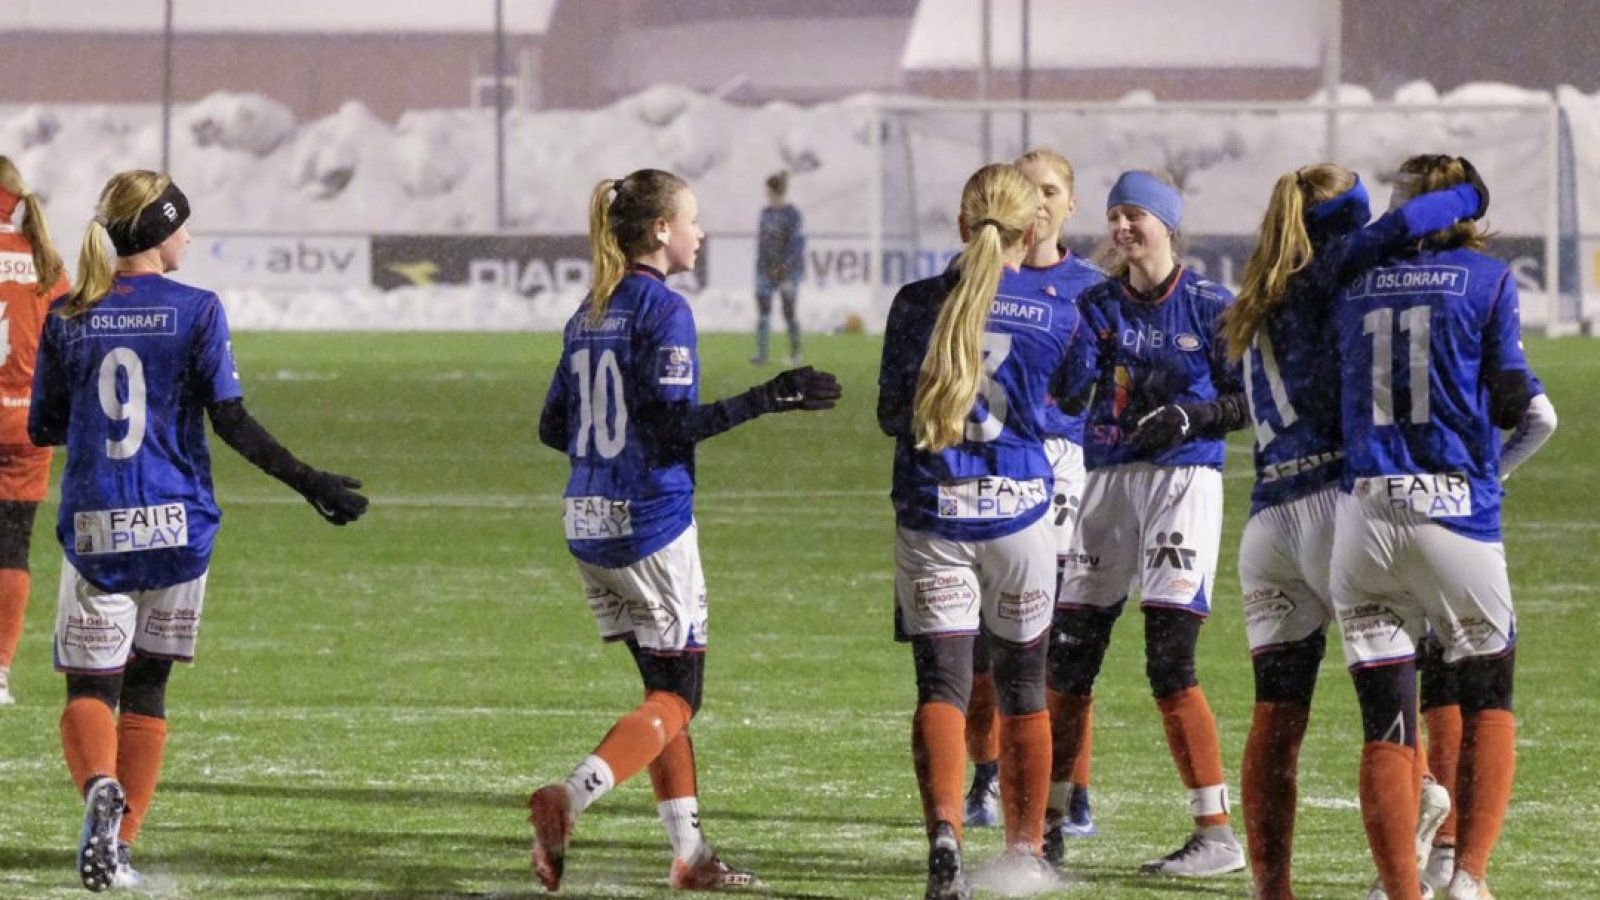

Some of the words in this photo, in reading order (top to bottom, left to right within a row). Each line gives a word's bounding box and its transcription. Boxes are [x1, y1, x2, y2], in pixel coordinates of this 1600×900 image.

[266, 242, 355, 273] abv
[1376, 271, 1458, 288] OSLOKRAFT
[91, 314, 168, 329] OSLOKRAFT
[991, 301, 1044, 322] OKRAFT
[1122, 327, 1164, 353] DNB
[1363, 305, 1431, 426] 11
[99, 347, 147, 460] 9
[570, 348, 628, 459] 10
[1387, 474, 1465, 497] FAIR
[110, 506, 184, 530] FAIR
[574, 499, 627, 517] FAIR
[112, 526, 184, 549] PLAY
